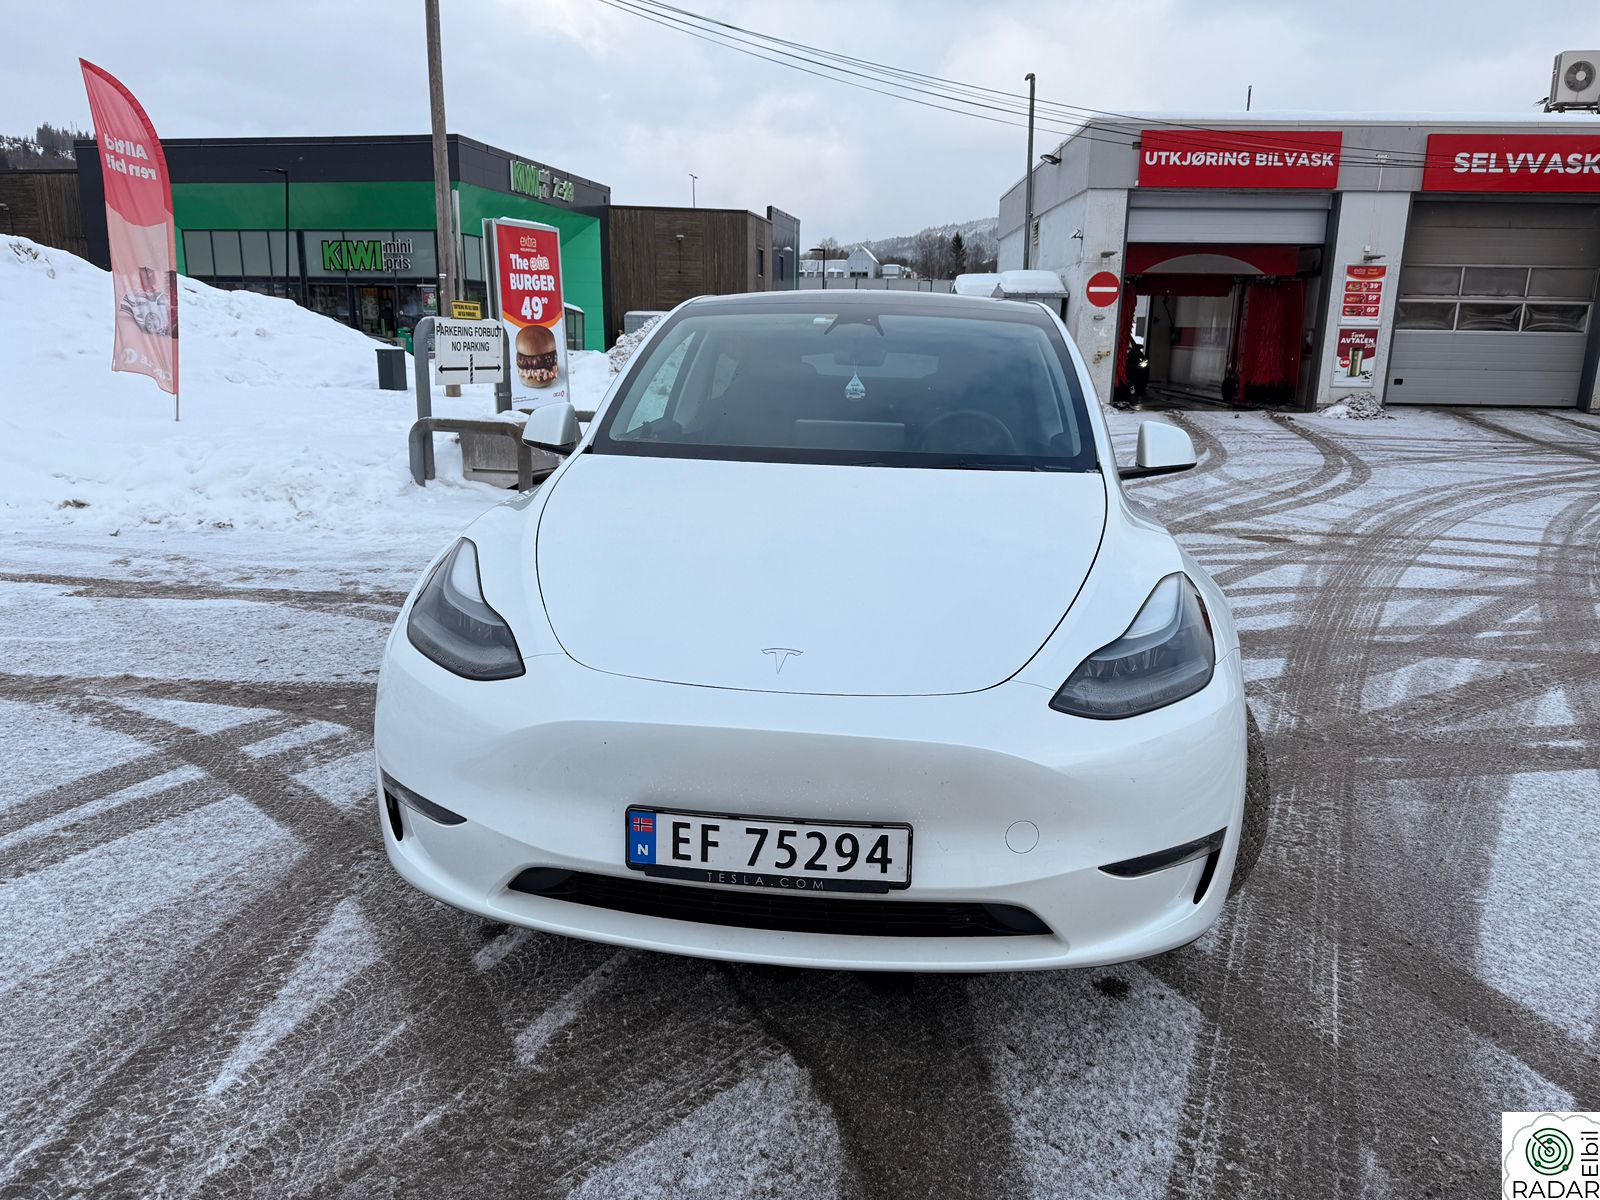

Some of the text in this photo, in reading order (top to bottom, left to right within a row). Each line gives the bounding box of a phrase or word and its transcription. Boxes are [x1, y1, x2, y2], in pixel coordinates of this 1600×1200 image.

[1145, 151, 1335, 167] UTKJØRING BILVASK
[1453, 152, 1600, 174] SELVVASK
[384, 239, 413, 254] mini
[321, 240, 384, 271] KIWI
[510, 253, 529, 270] The
[385, 256, 412, 272] pris
[509, 273, 555, 292] BURGER
[436, 325, 502, 338] PARKERING FORBUDT
[452, 341, 490, 352] NO PARKING
[637, 844, 649, 856] N
[672, 821, 893, 874] EF 75294
[707, 872, 824, 890] TESLA.COM
